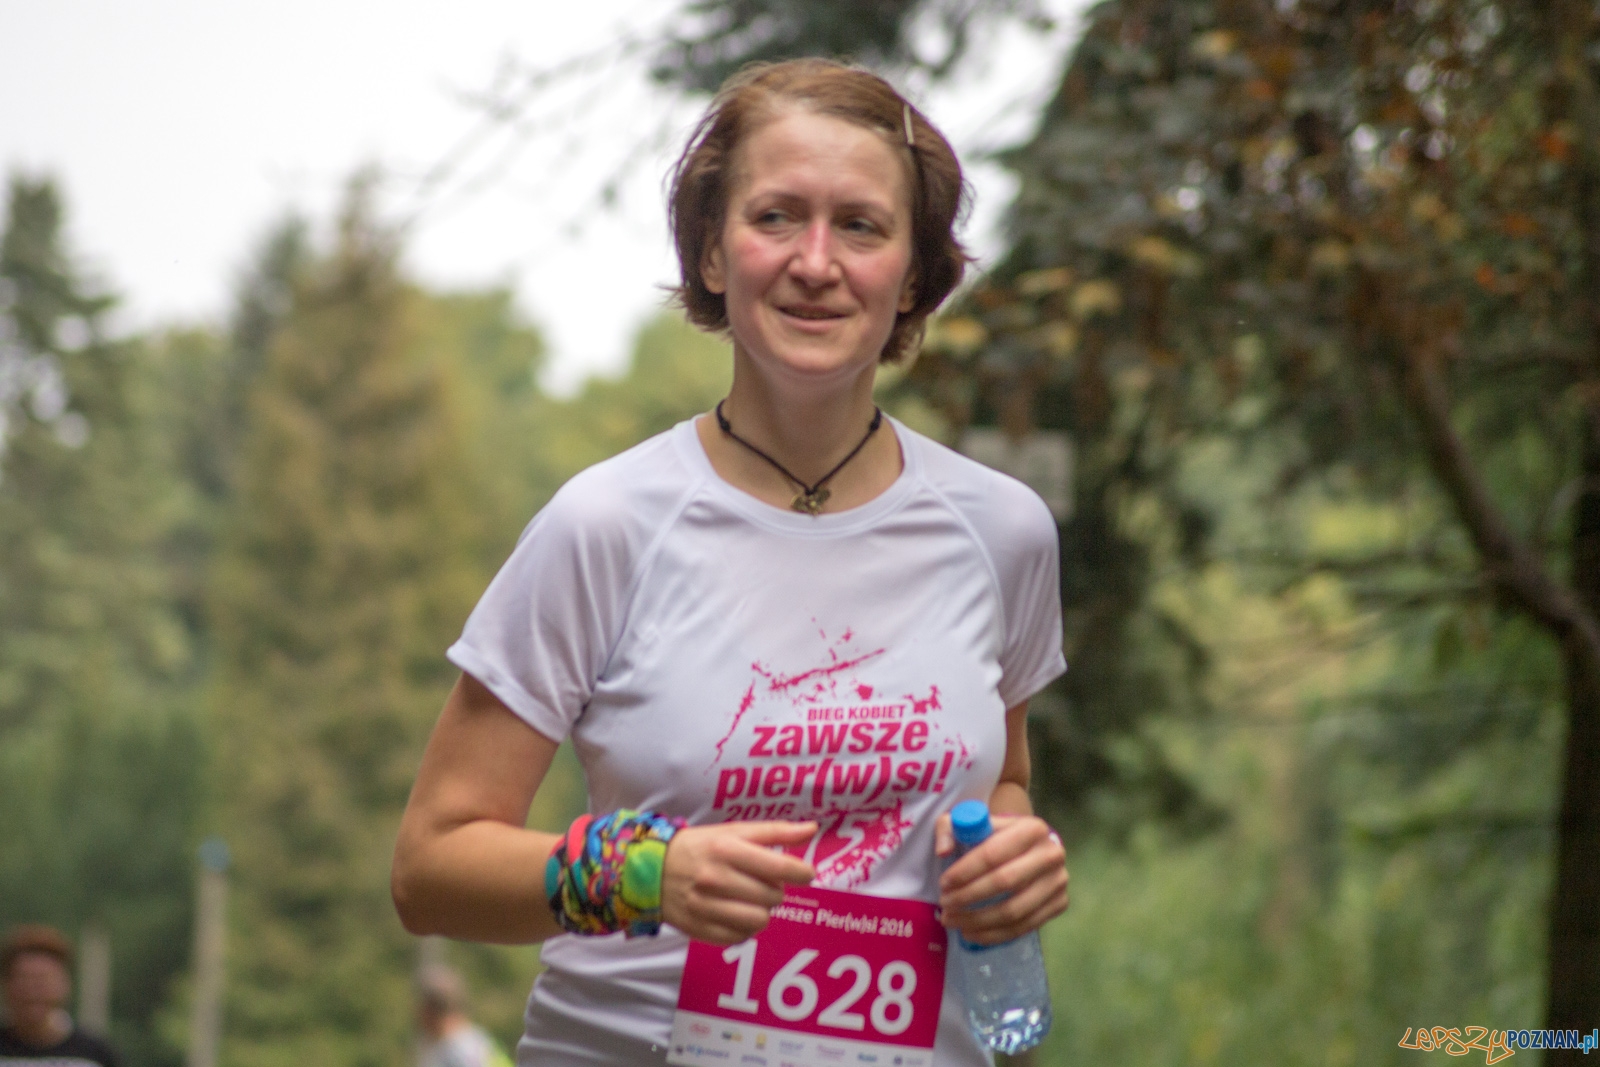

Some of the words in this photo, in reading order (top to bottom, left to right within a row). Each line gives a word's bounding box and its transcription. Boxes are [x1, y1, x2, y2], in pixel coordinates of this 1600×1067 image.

[807, 707, 844, 721] BIEG
[847, 704, 907, 720] KOBIET
[748, 720, 929, 757] zawsze
[712, 751, 955, 809] pier(w)si!
[815, 908, 879, 934] Pier(w)si
[878, 917, 914, 938] 2016
[717, 938, 917, 1036] 1628
